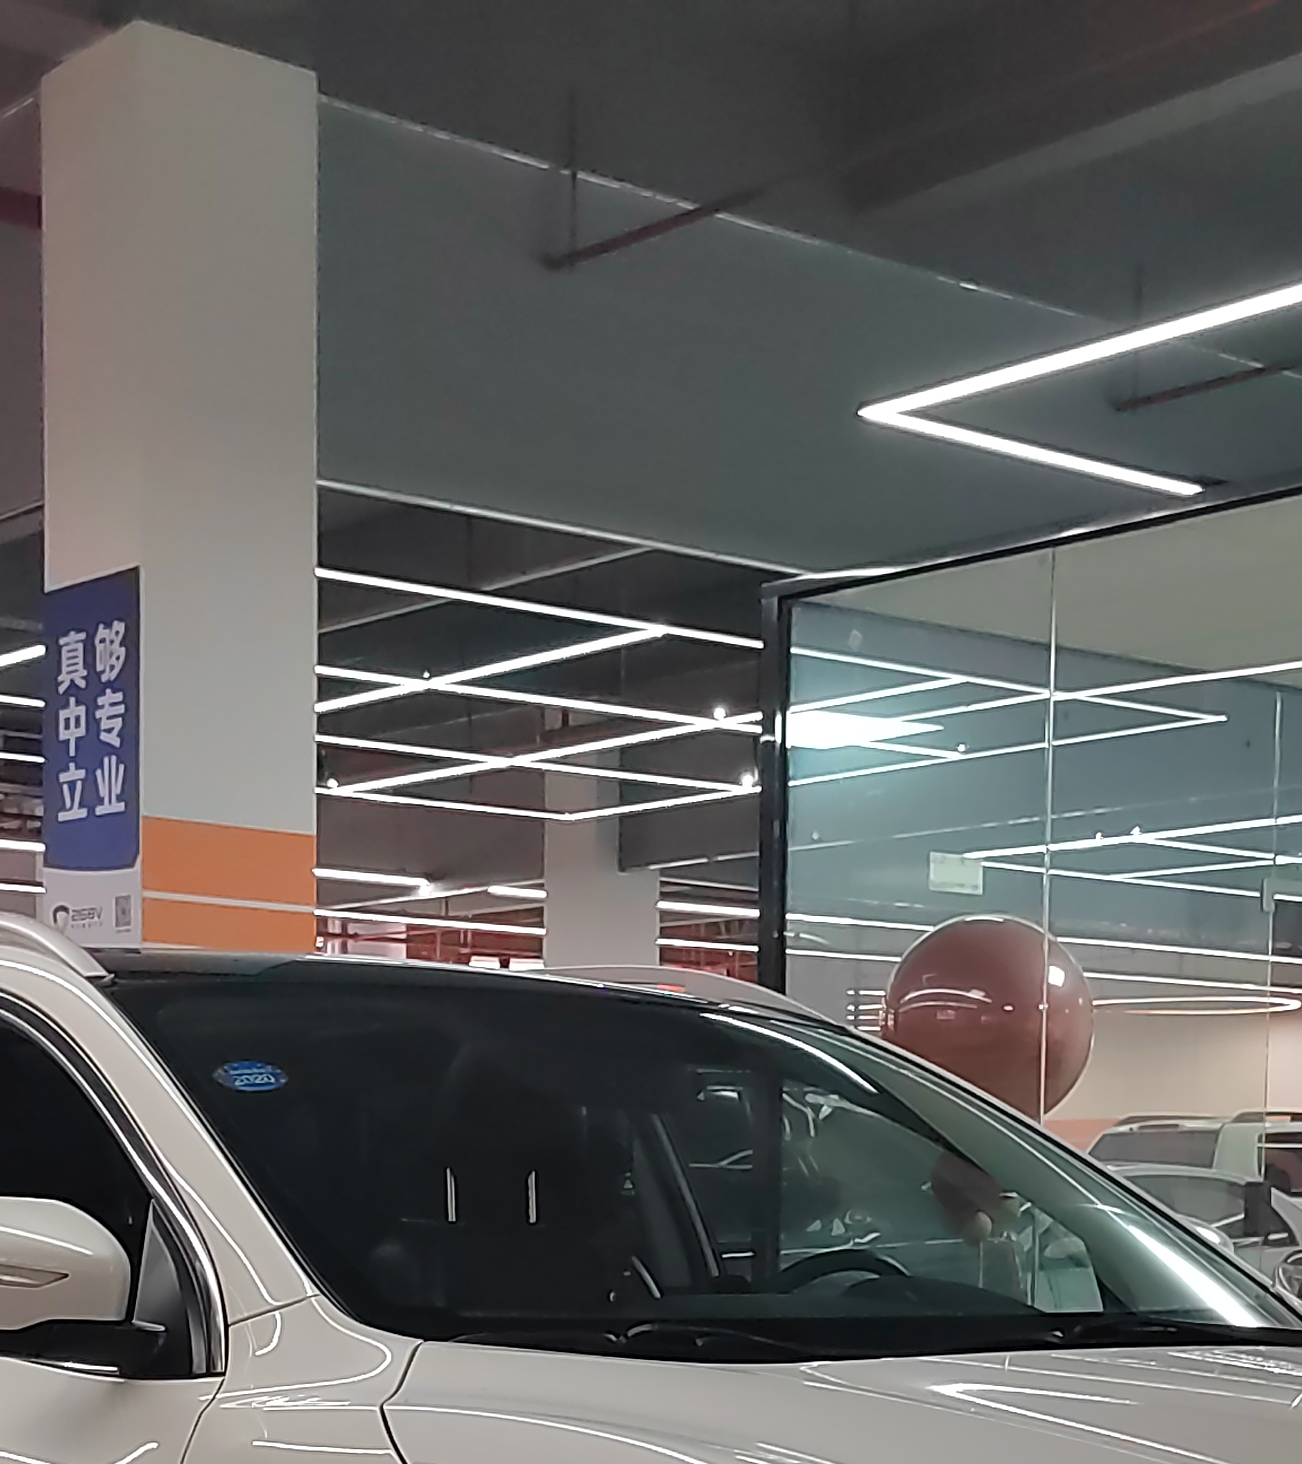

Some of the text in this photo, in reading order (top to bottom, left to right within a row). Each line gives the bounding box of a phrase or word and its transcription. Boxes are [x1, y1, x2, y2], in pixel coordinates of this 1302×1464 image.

[57, 630, 88, 823] 真中立
[94, 619, 126, 816] 够专业
